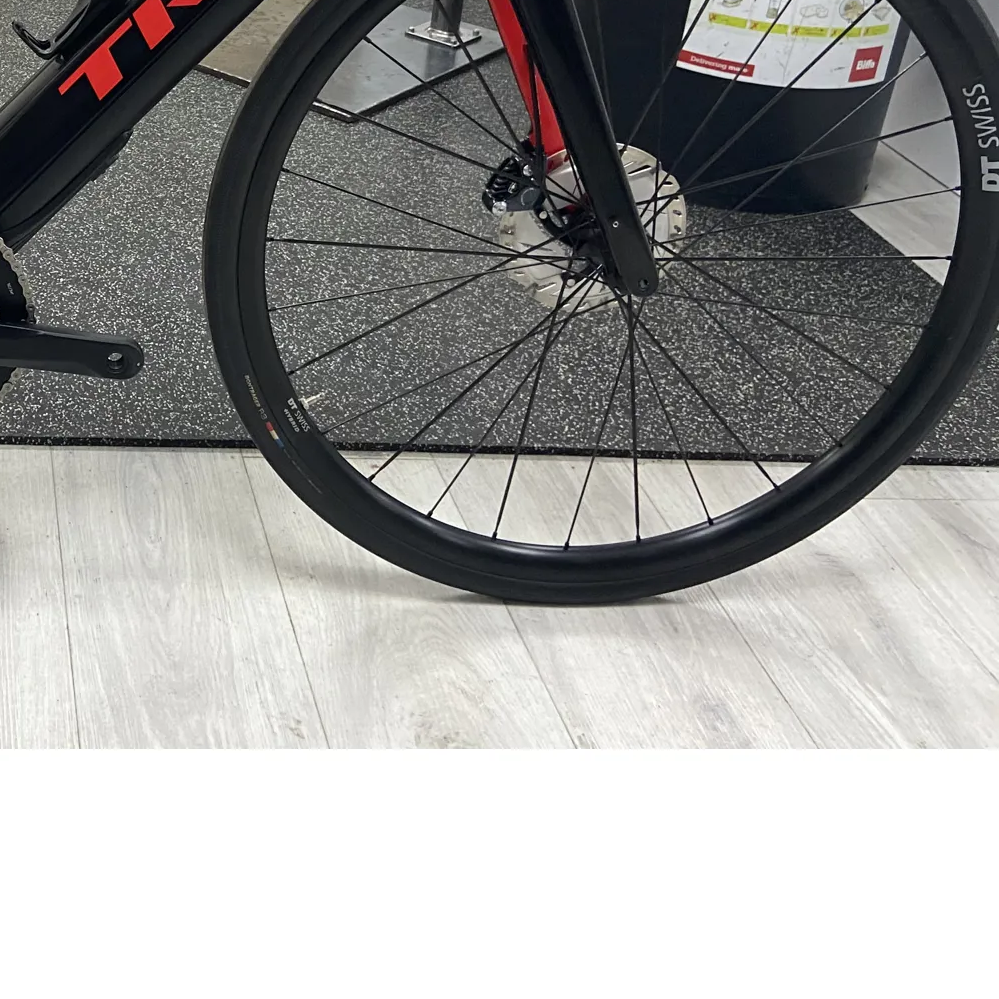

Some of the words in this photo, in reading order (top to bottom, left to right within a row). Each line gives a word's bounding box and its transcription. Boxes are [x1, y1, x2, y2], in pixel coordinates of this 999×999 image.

[962, 83, 999, 149] SWISS
[283, 408, 300, 433] HYBRID
[287, 397, 298, 410] DT
[295, 409, 311, 433] SWISS
